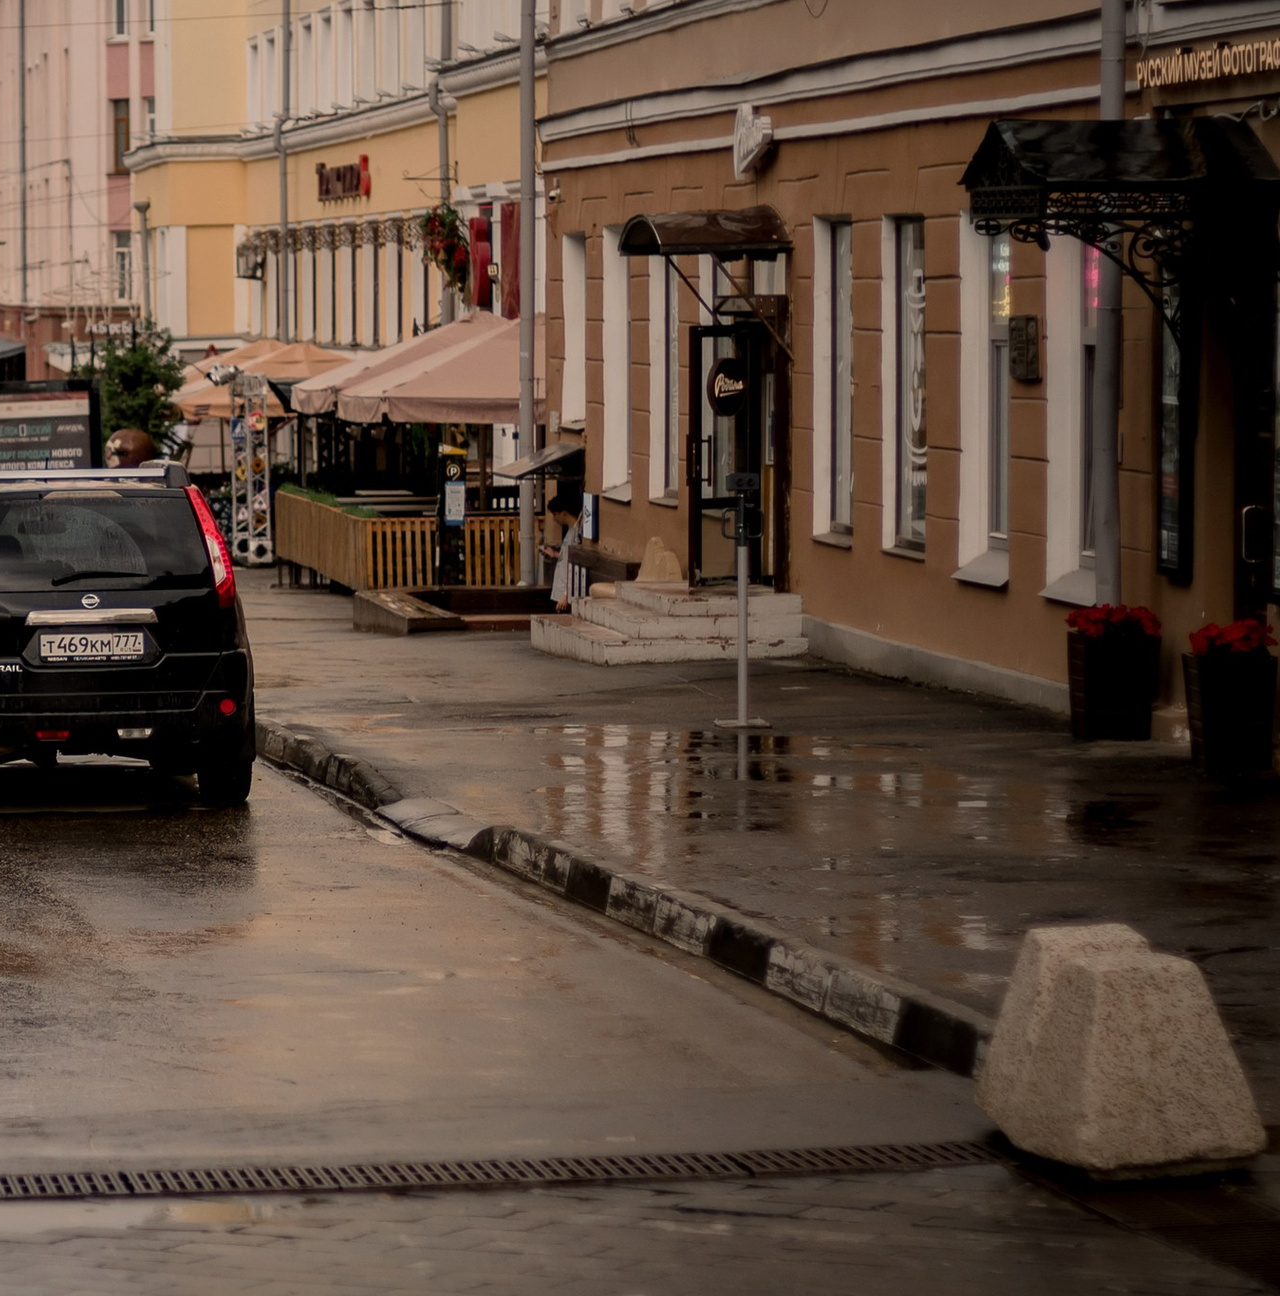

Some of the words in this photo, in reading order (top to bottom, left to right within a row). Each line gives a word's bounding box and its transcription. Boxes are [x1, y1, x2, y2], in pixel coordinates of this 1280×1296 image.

[1136, 47, 1183, 89] РУССКИЙ
[1184, 42, 1221, 82] МУЗЕЙ
[18, 448, 51, 459] ПРОДАЖ
[51, 447, 83, 458] НОВОГО
[114, 635, 139, 648] 777
